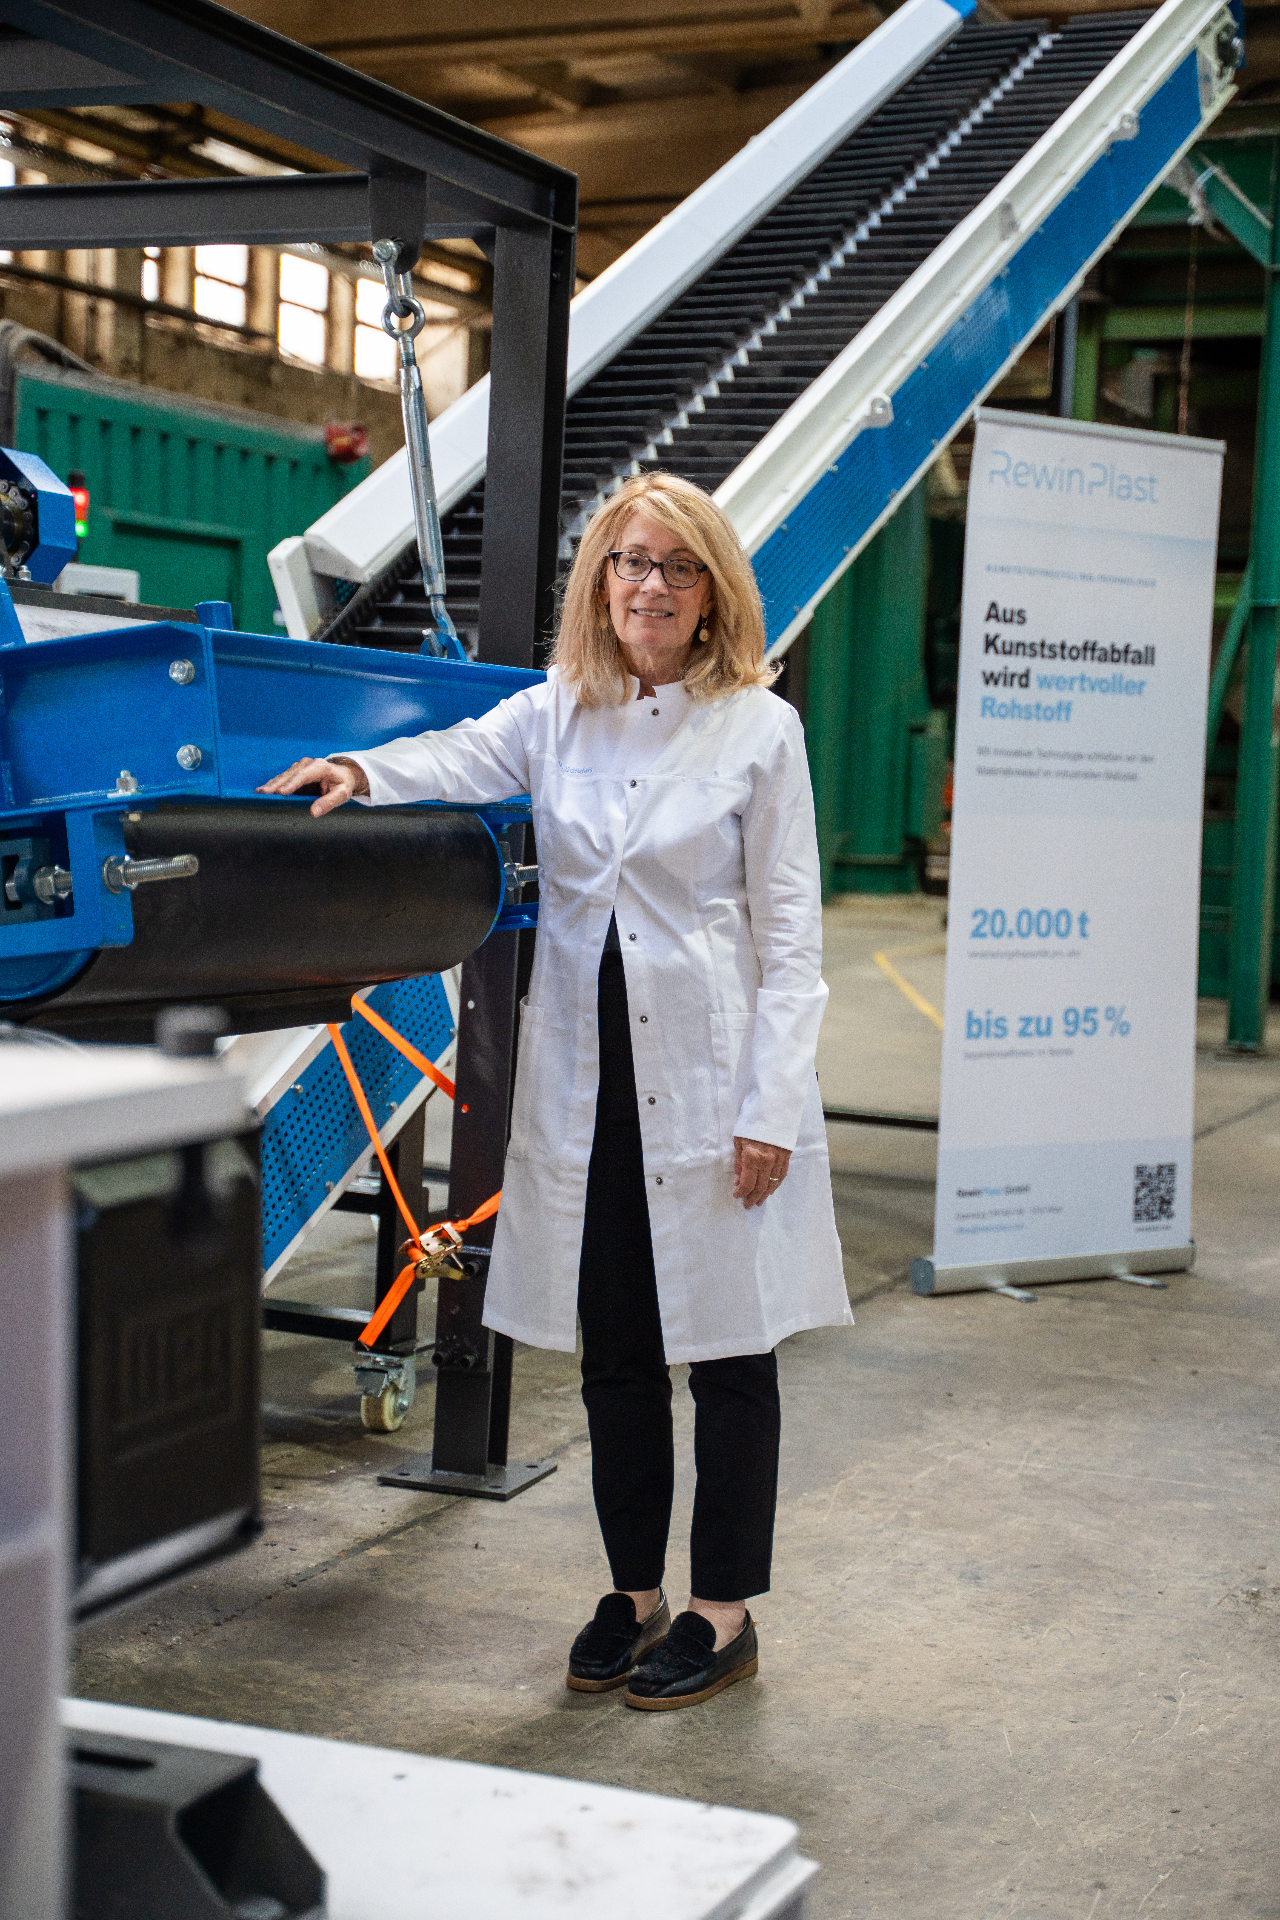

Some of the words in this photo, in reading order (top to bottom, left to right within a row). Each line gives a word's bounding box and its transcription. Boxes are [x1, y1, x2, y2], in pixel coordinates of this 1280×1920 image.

[989, 450, 1158, 504] RewinPlast
[984, 601, 1027, 625] Aus
[983, 634, 1156, 667] Kunststoffabfall
[982, 667, 1030, 689] wird
[1036, 672, 1146, 696] wertvoller
[980, 696, 1073, 723] Rohstoff
[965, 1009, 1008, 1040] bis
[1017, 1015, 1052, 1038] zu
